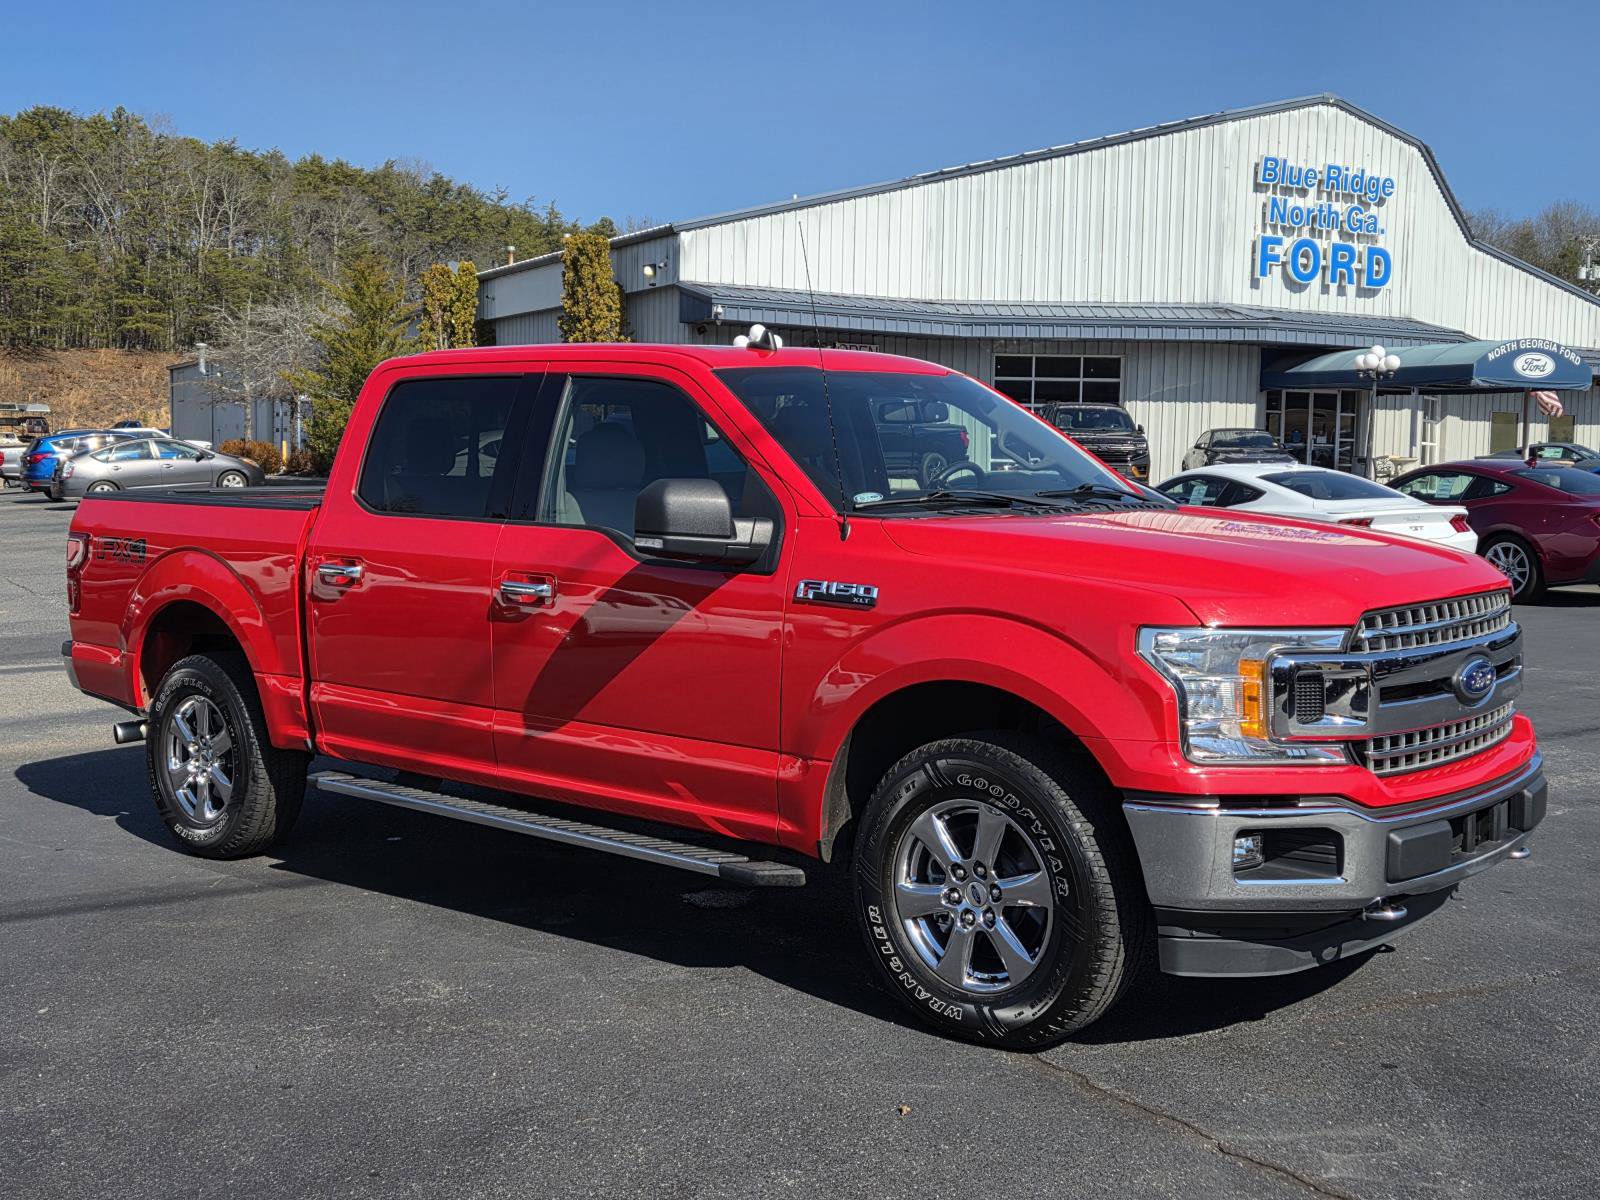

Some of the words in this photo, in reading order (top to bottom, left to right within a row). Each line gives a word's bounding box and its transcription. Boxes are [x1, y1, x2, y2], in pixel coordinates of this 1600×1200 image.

[1259, 155, 1318, 188] Blue
[1324, 163, 1396, 203] Ridge
[1268, 196, 1340, 230] North
[1345, 204, 1386, 235] Ga.
[1257, 234, 1392, 288] FORD
[1487, 341, 1518, 361] NORTH
[1519, 339, 1558, 353] GEORGIA
[1559, 347, 1581, 366] FORD
[1521, 357, 1548, 372] Ford
[853, 596, 870, 604] XLT
[957, 773, 1069, 897] GOODYEAR
[868, 905, 963, 1020] WRANGLER
